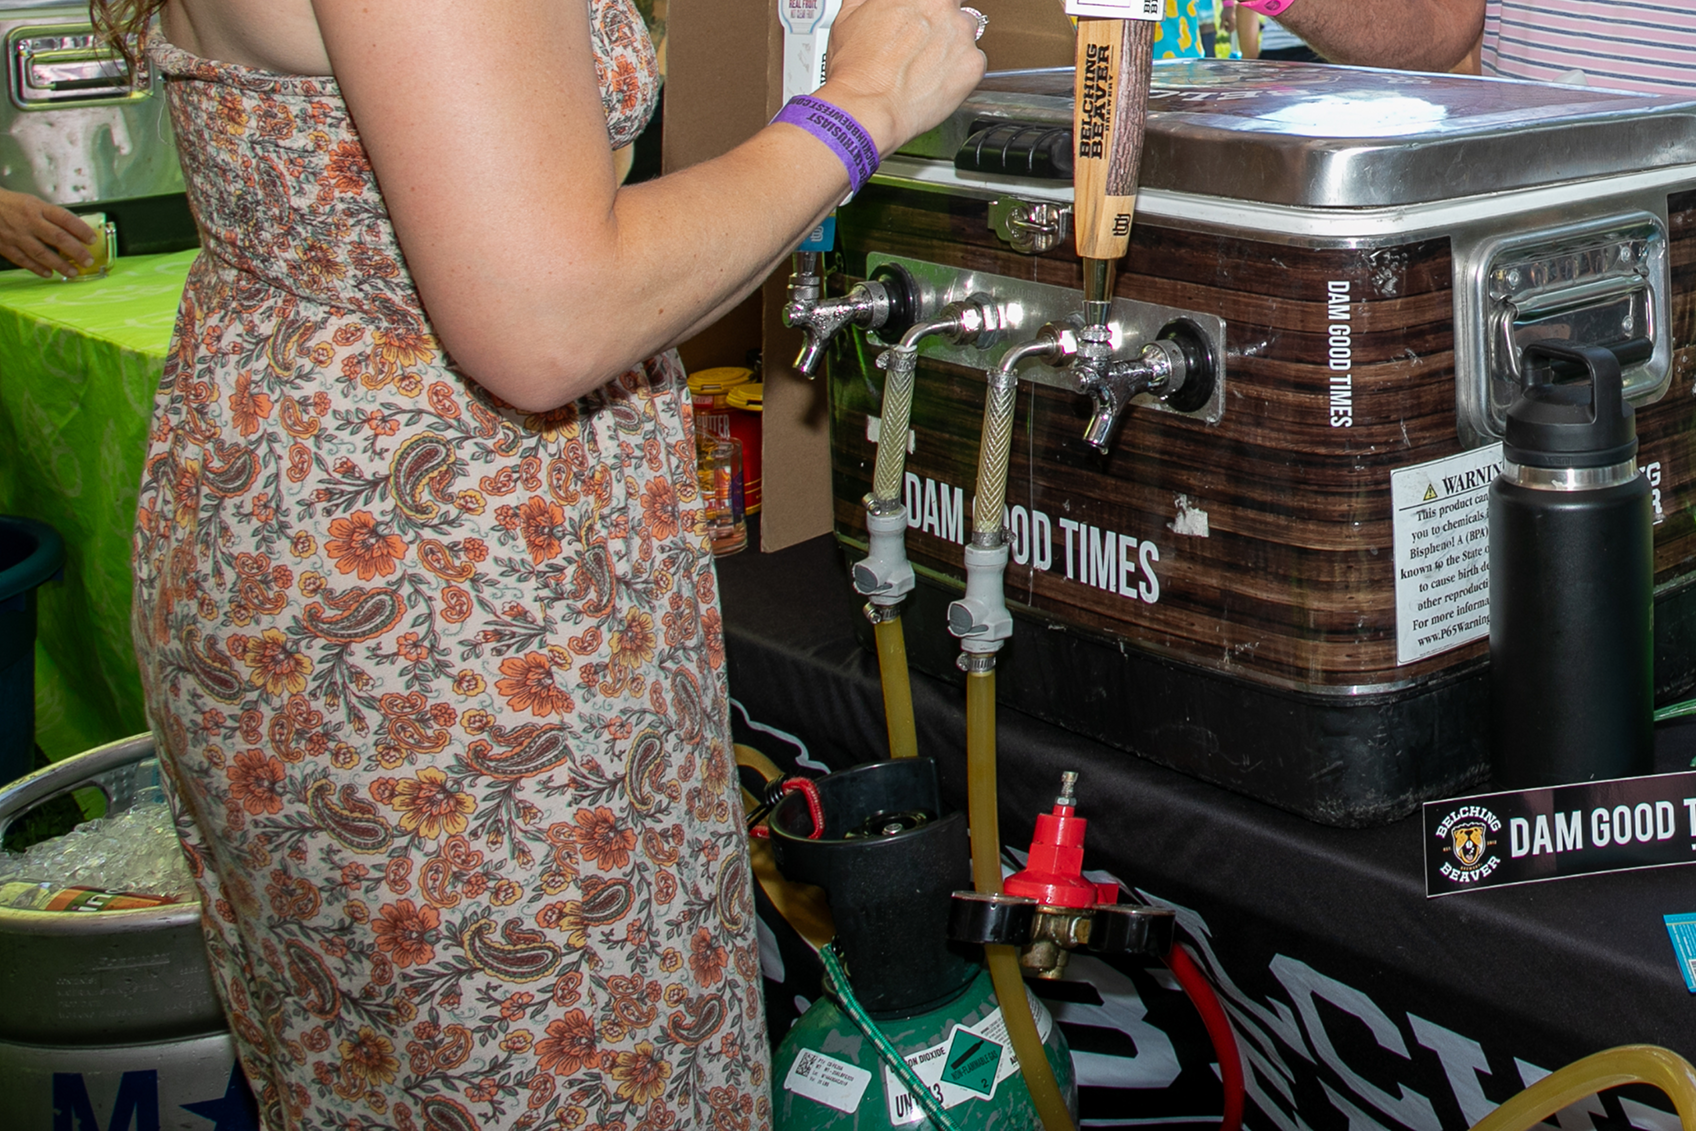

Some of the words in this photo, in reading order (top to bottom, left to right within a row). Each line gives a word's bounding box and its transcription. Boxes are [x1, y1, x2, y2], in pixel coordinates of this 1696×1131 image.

[788, 0, 801, 9] REAL
[1079, 43, 1097, 159] BELCHING
[1090, 44, 1111, 160] BEAVER
[1105, 75, 1114, 131] BREWERY
[806, 112, 865, 167] ENTHUSIAST
[1327, 280, 1350, 320] DAM
[1327, 324, 1351, 371] GOOD
[1329, 373, 1352, 428] TIMES
[696, 413, 731, 439] BUTTER
[1442, 462, 1503, 496] WARNIN
[1416, 508, 1437, 522] This
[1439, 495, 1473, 518] product
[1475, 493, 1488, 506] can
[904, 471, 964, 545] DAM
[1059, 519, 1161, 605] TIMES
[1409, 536, 1455, 560] Bisphenol
[1457, 537, 1464, 547] A
[1466, 525, 1489, 547] (BPA)
[1411, 528, 1429, 545] you
[1431, 524, 1441, 535] to
[1442, 510, 1484, 533] chemicals
[1400, 564, 1433, 580] known
[1434, 559, 1444, 574] to
[1446, 554, 1461, 567] the
[1461, 548, 1482, 562] State
[1419, 582, 1429, 593] to
[1431, 575, 1456, 589] cause
[1458, 564, 1479, 580] birth
[1417, 595, 1443, 611] other
[1444, 578, 1489, 604] reproducti
[1412, 617, 1429, 631] For
[1431, 609, 1455, 624] more
[1456, 596, 1490, 616] informa
[1435, 805, 1502, 839] BELCHING
[1510, 809, 1584, 859] DAM
[1591, 800, 1675, 848] GOOD
[1439, 855, 1501, 883] BEAVER
[918, 1047, 945, 1063] DIOXIDE
[984, 1049, 998, 1063] GAS
[980, 1078, 989, 1089] 2
